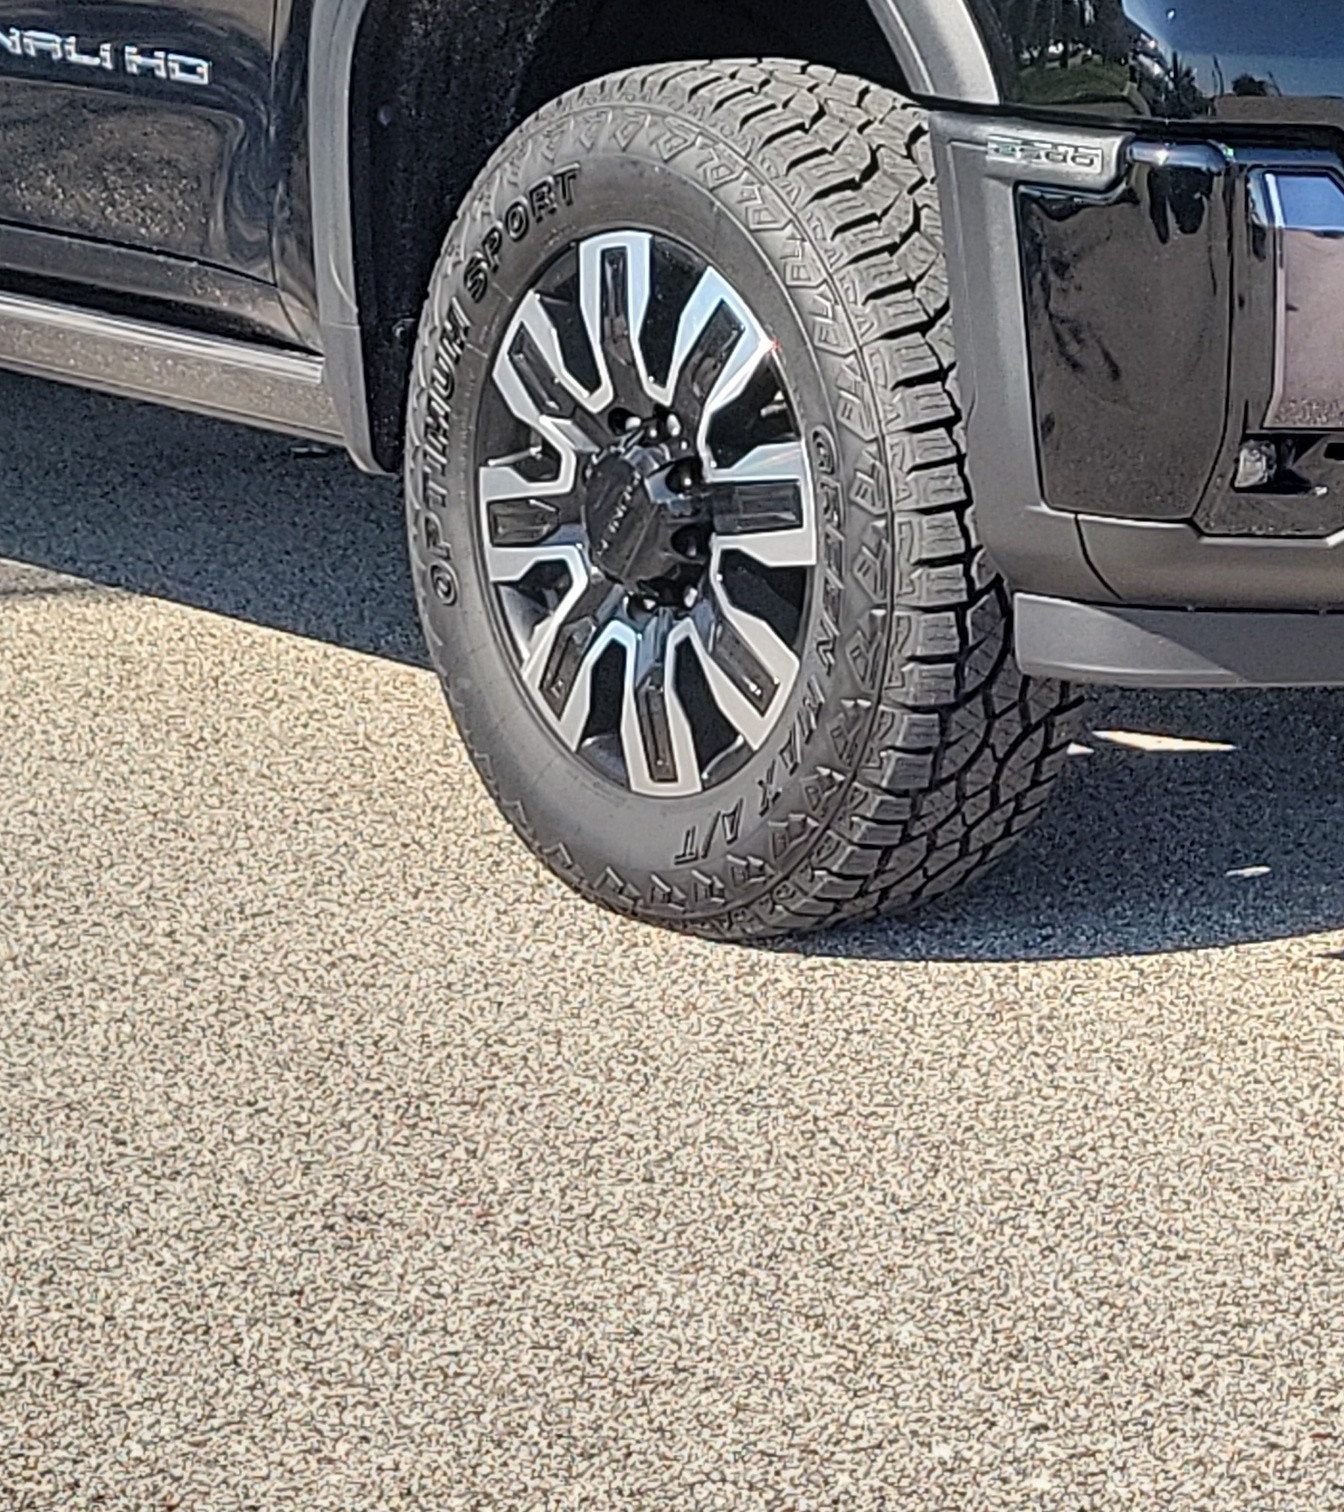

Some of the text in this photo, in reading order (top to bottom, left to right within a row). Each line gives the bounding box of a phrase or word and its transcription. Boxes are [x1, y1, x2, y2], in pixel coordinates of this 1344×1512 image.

[123, 44, 213, 86] HD
[422, 161, 581, 606] OPTIMUM SPORT
[673, 796, 745, 866] A/T
